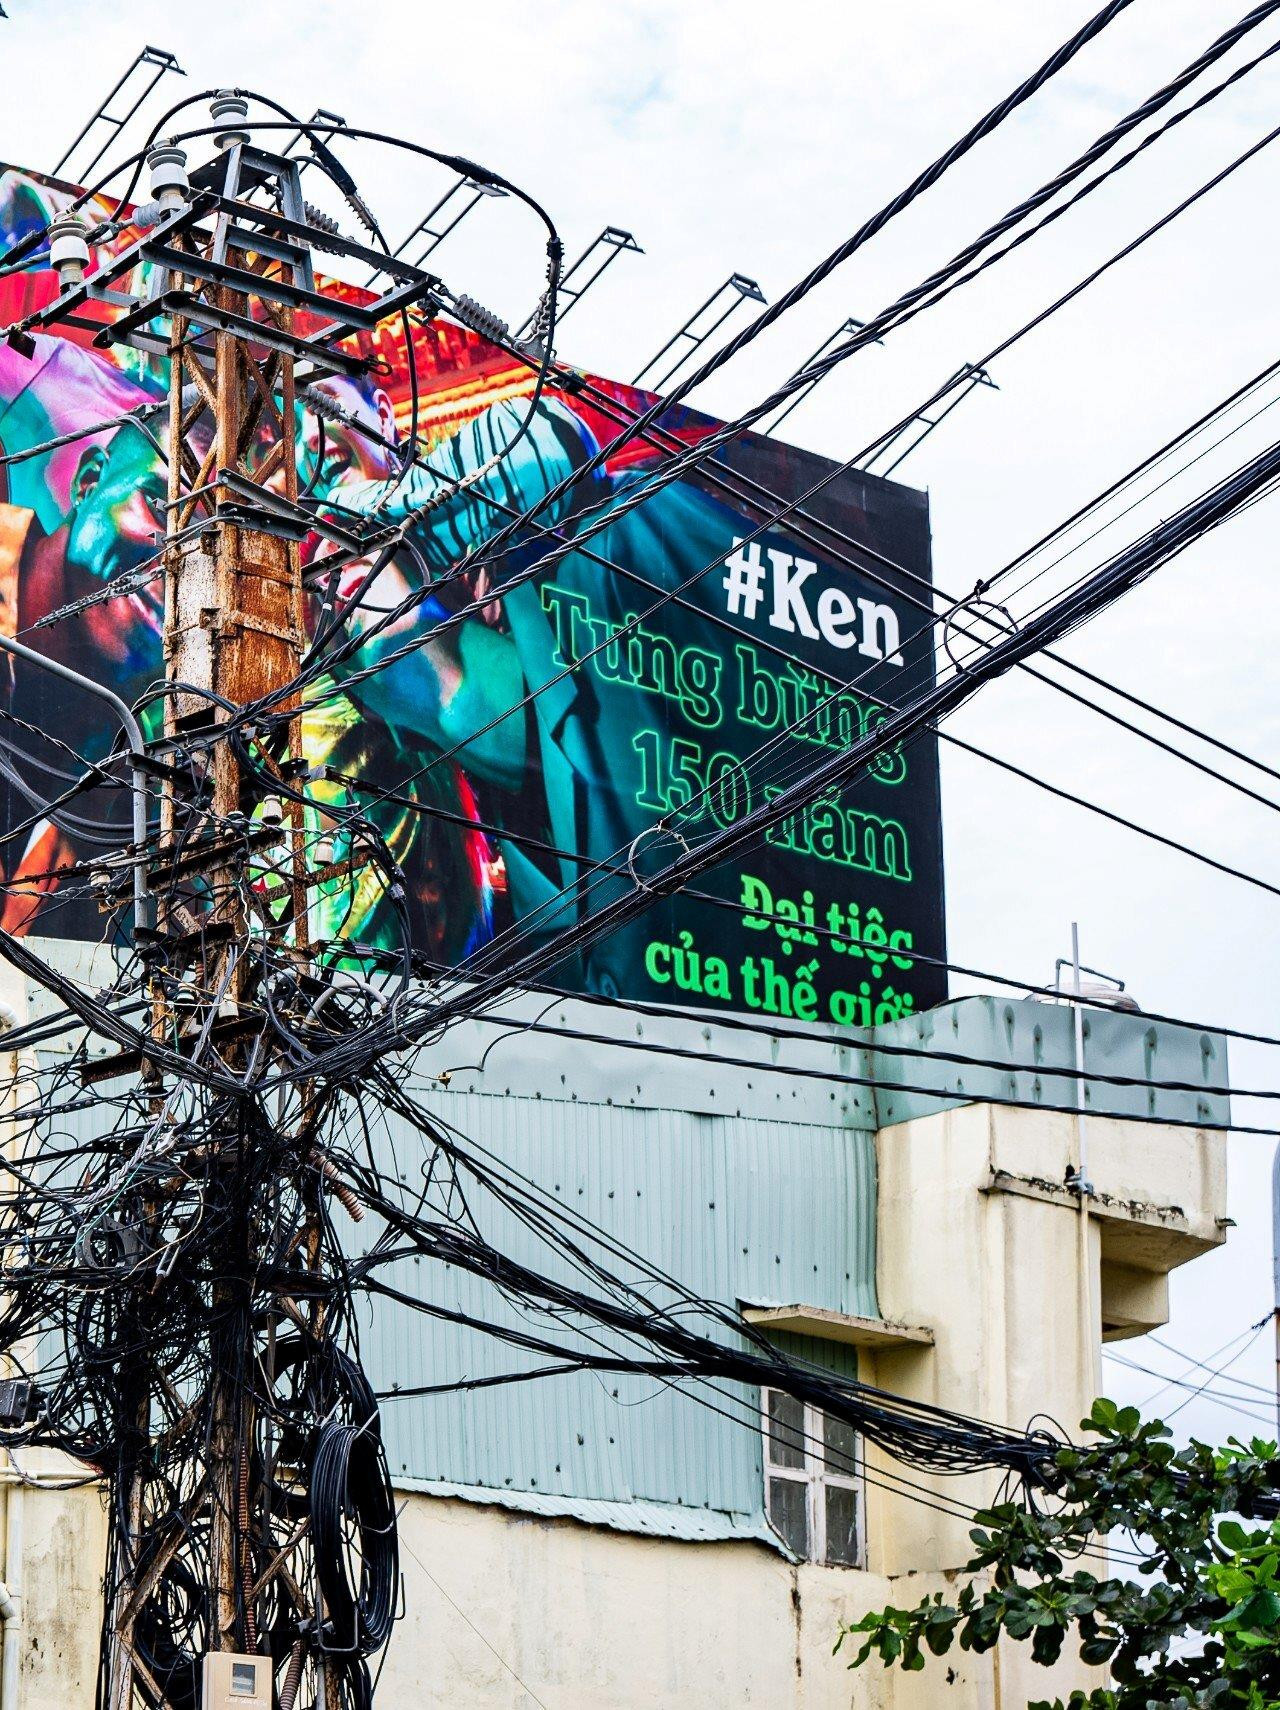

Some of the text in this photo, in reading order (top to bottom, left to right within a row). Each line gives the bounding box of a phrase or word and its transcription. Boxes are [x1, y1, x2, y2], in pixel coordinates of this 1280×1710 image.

[722, 535, 904, 667] #Ken
[541, 584, 722, 729] Tưng
[632, 729, 751, 832] 150
[644, 930, 732, 1001] của
[739, 954, 820, 1022] thế
[740, 873, 914, 980] Đại tiệc
